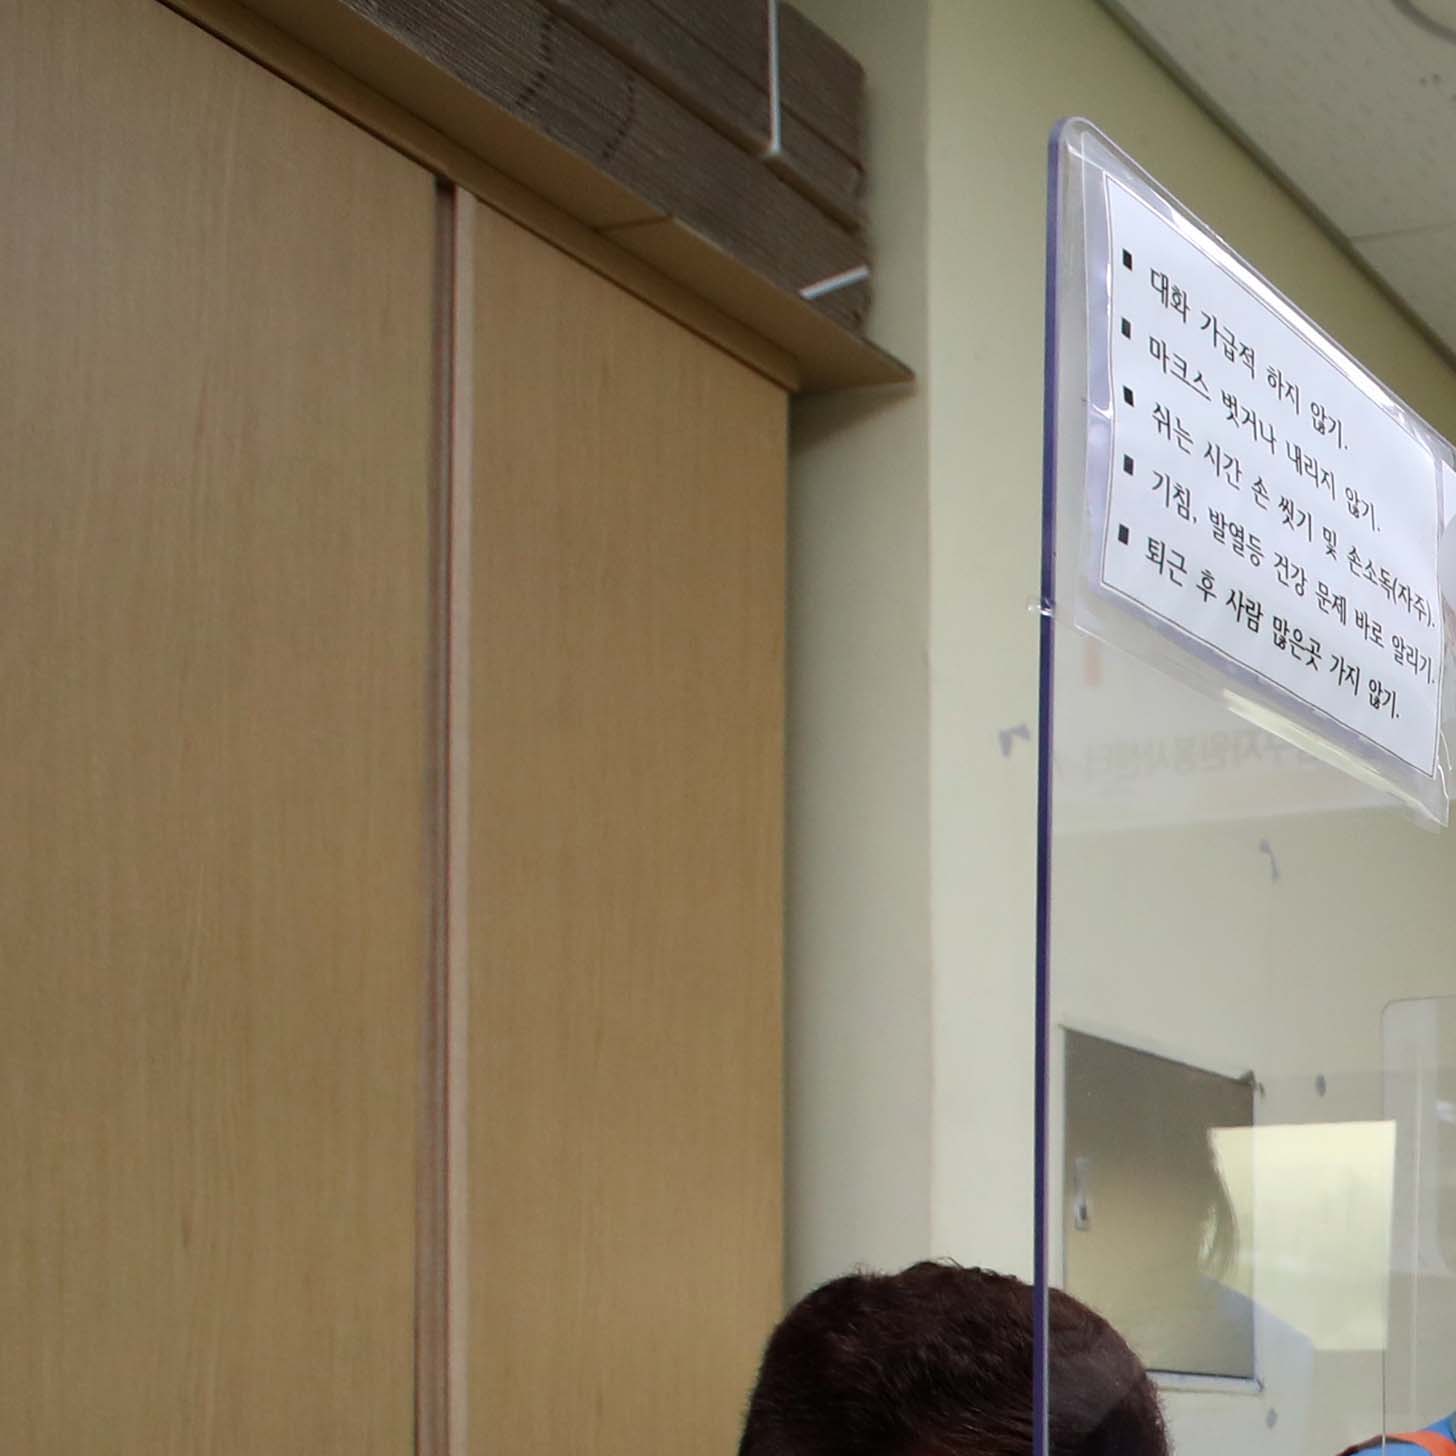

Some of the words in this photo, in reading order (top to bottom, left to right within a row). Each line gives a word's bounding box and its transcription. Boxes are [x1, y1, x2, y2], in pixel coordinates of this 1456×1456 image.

[1150, 268, 1190, 324] 대화
[1200, 310, 1255, 380] 가급적
[1266, 366, 1300, 416] 하지
[1311, 402, 1349, 450] 않기.
[1152, 402, 1194, 455] 쉬는
[1203, 441, 1242, 490] 시간
[1251, 476, 1270, 511] 손
[1278, 496, 1312, 543] 씻기
[1322, 526, 1337, 561] 및
[1347, 545, 1436, 628] 손소독(자주).
[1220, 390, 1277, 455] 벗거나
[1286, 440, 1336, 501] 내리지
[1345, 487, 1381, 532] 않기.
[1145, 536, 1188, 588] 퇴근
[1196, 568, 1217, 603] 후
[1225, 588, 1264, 634] 사람
[1272, 615, 1323, 672] 많은곳
[1329, 654, 1360, 697] 가지
[1369, 679, 1400, 719] 않기.
[1151, 470, 1197, 524] 기침,
[1207, 507, 1264, 568] 발열등
[1274, 552, 1308, 597] 건강
[1315, 581, 1347, 626] 문제
[1355, 608, 1384, 649] 바로
[1391, 634, 1435, 685] 알리기.
